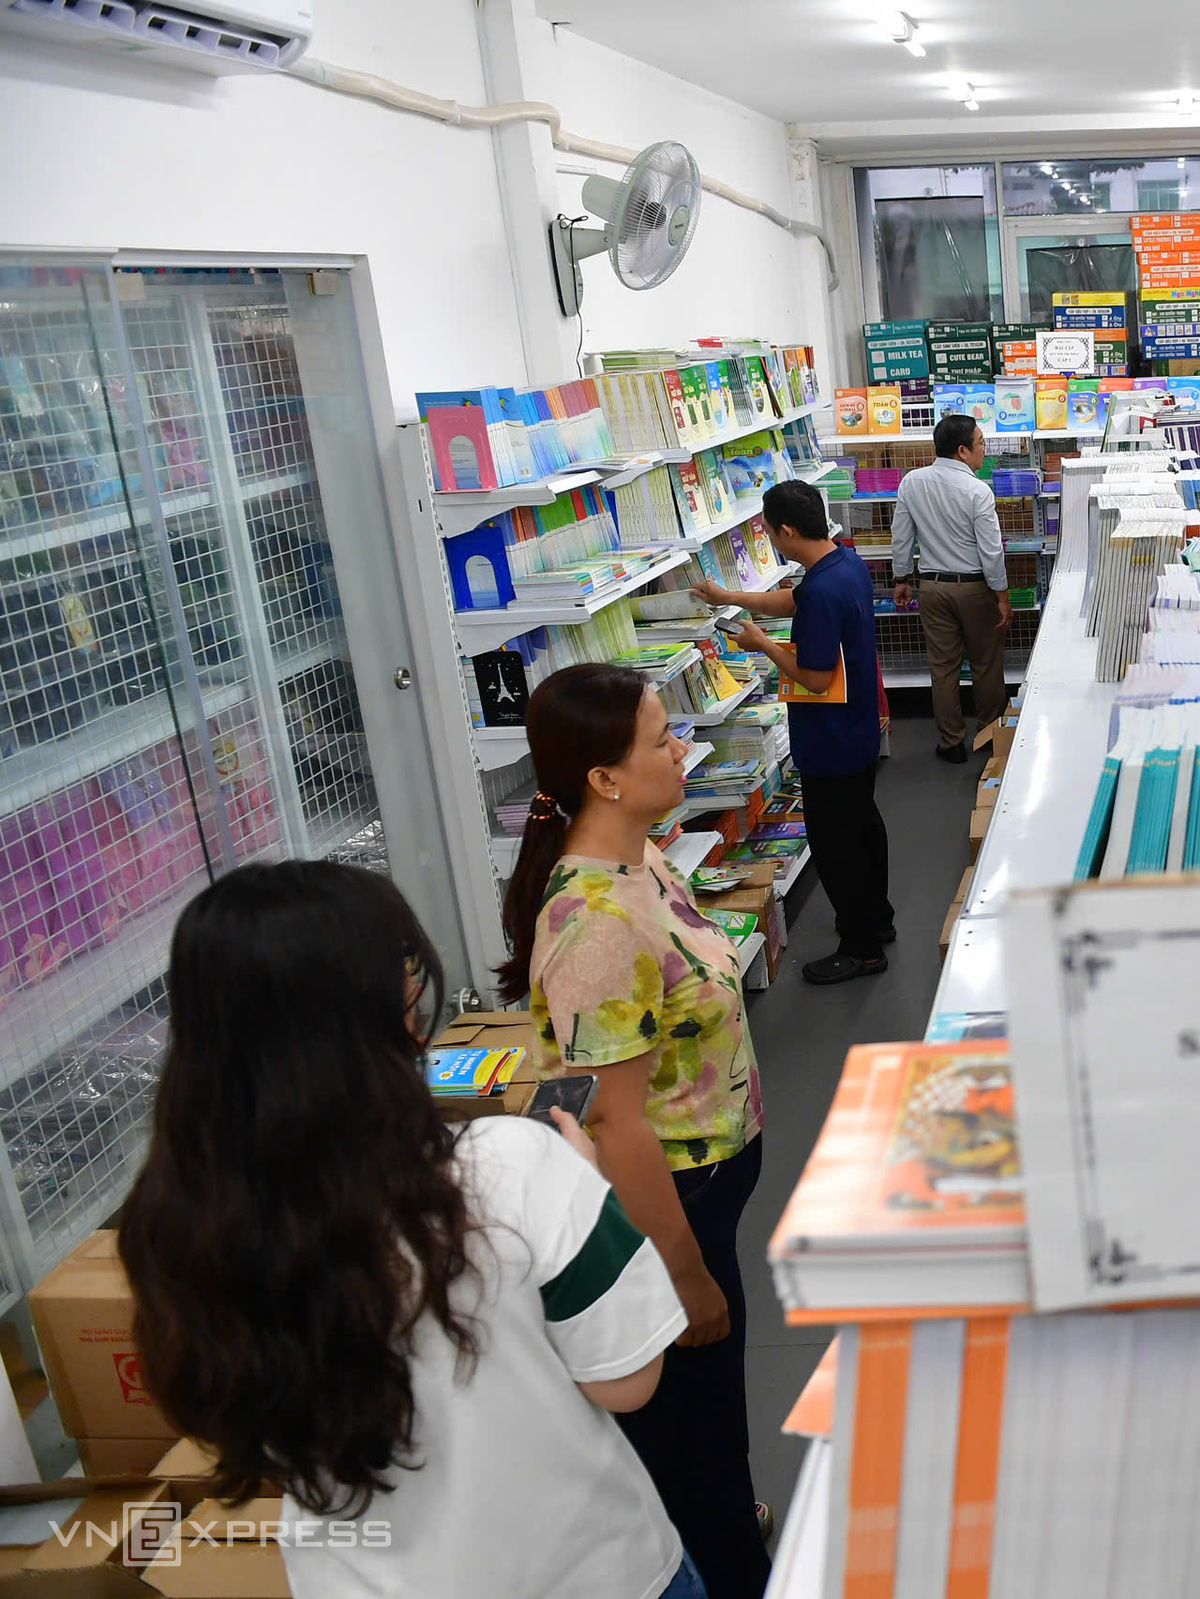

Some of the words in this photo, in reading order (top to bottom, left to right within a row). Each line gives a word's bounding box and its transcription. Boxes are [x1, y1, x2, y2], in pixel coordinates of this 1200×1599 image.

[888, 351, 907, 359] MILK
[908, 350, 923, 358] TEA
[967, 353, 984, 361] BEAR
[890, 368, 911, 376] CARO
